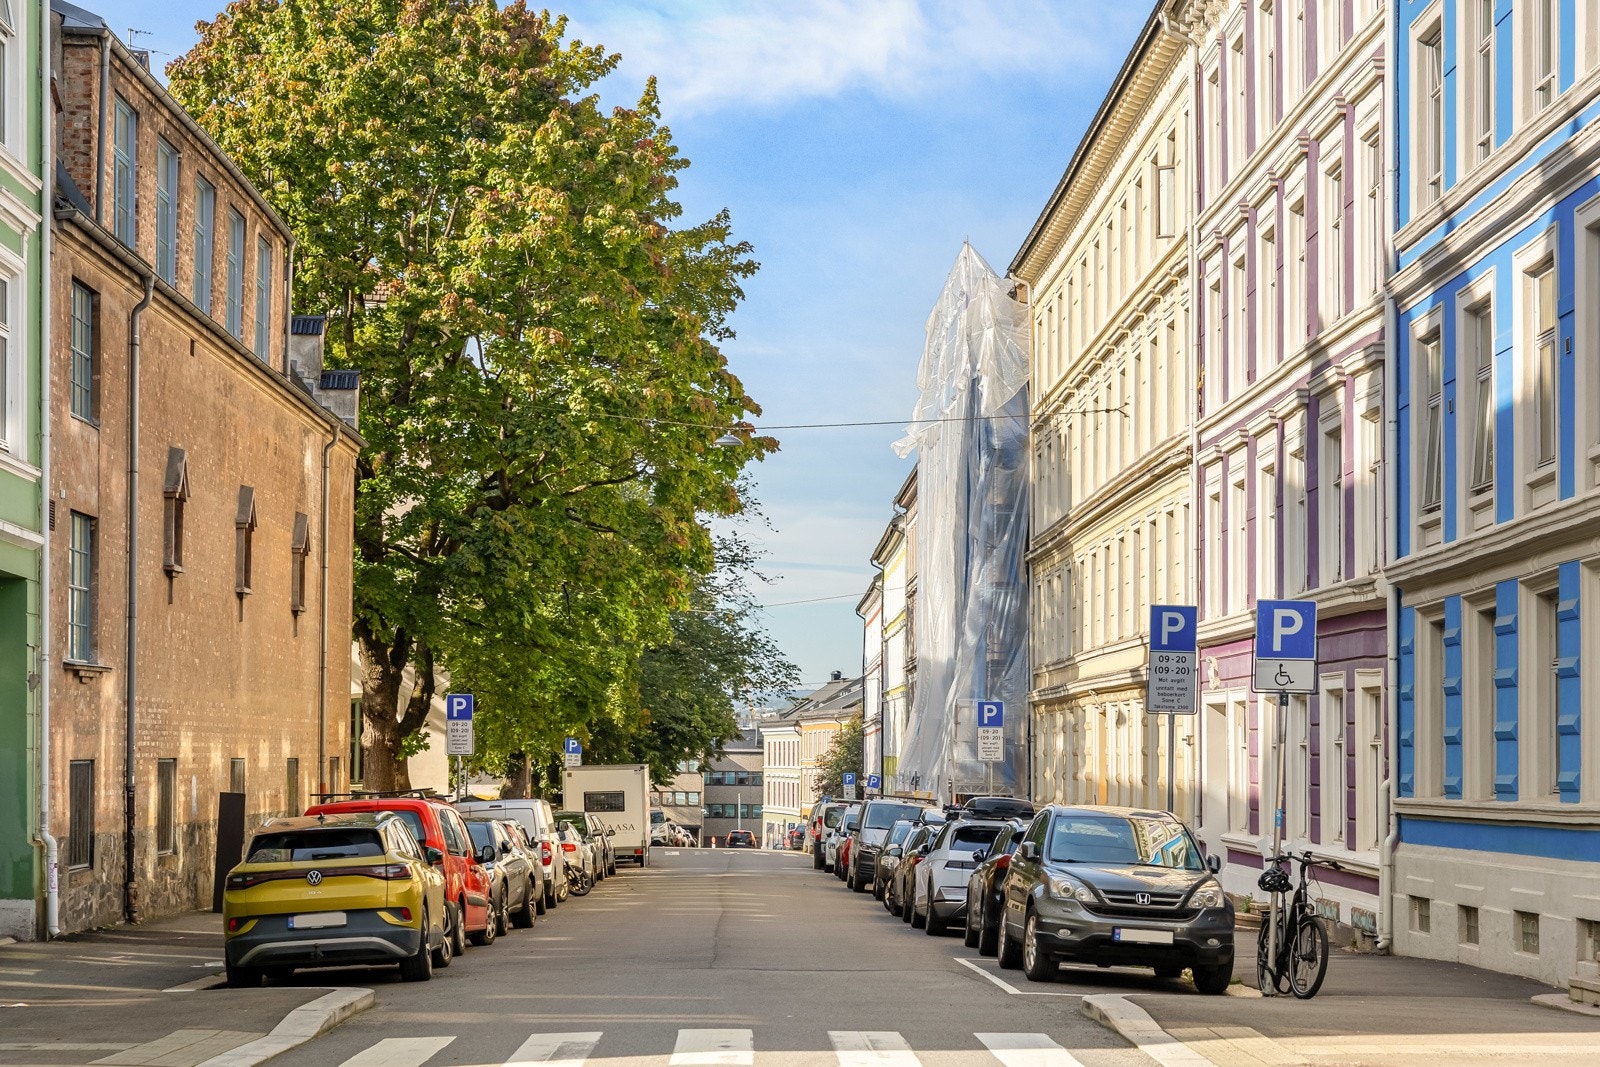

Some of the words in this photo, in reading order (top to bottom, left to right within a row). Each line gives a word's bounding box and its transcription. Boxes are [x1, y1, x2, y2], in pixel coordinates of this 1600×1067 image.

[1161, 611, 1186, 645] P
[1273, 609, 1303, 651] P
[453, 698, 466, 717] P
[984, 705, 997, 723] P
[569, 739, 578, 752] P
[846, 775, 852, 783] P
[870, 777, 877, 786] P
